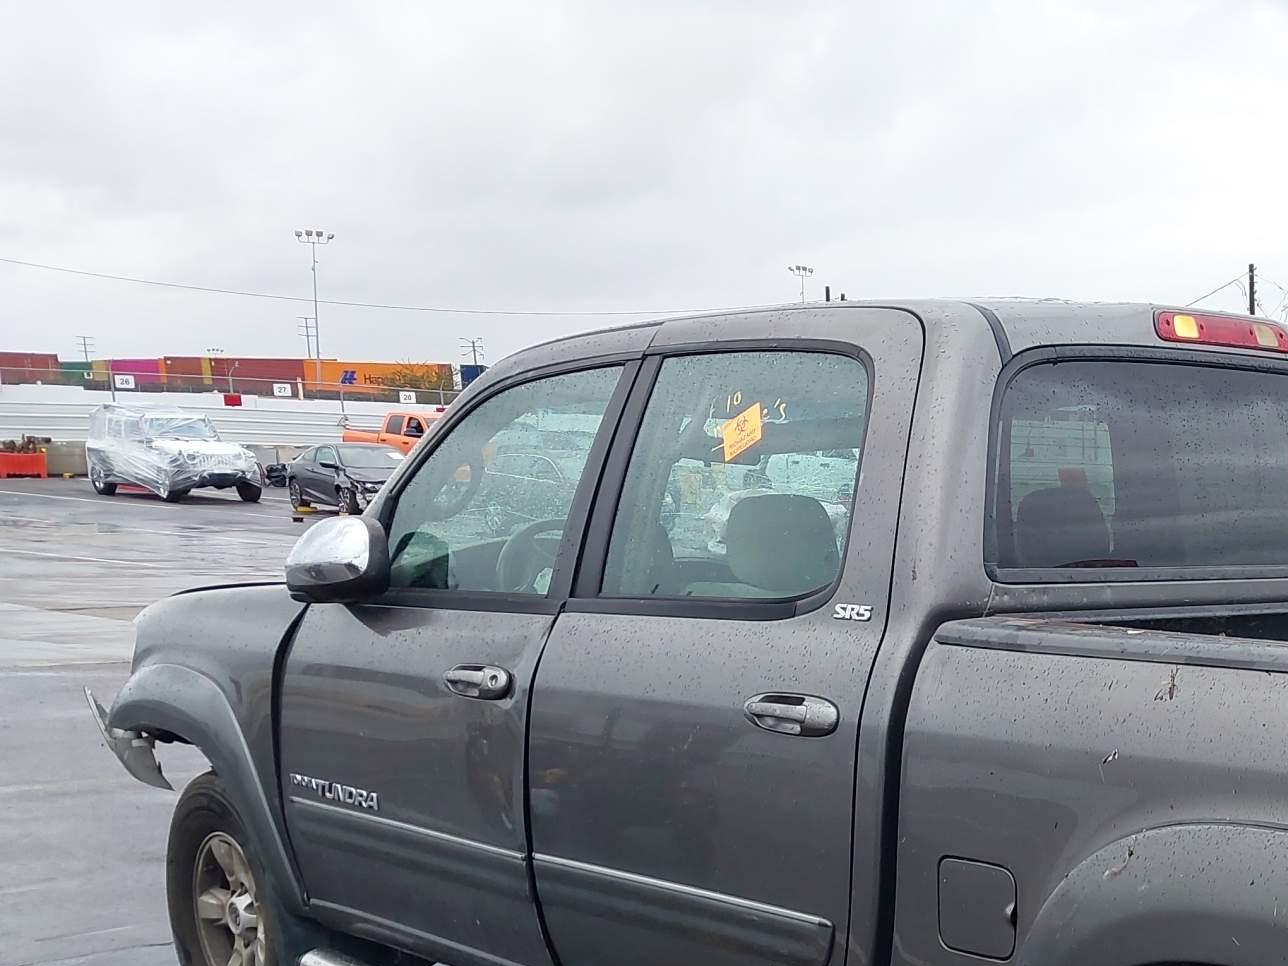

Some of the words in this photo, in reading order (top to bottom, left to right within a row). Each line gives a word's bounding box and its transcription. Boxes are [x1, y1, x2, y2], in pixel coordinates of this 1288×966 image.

[277, 386, 287, 394] 27
[833, 603, 873, 621] SR5
[315, 778, 379, 811] TUNDRA
